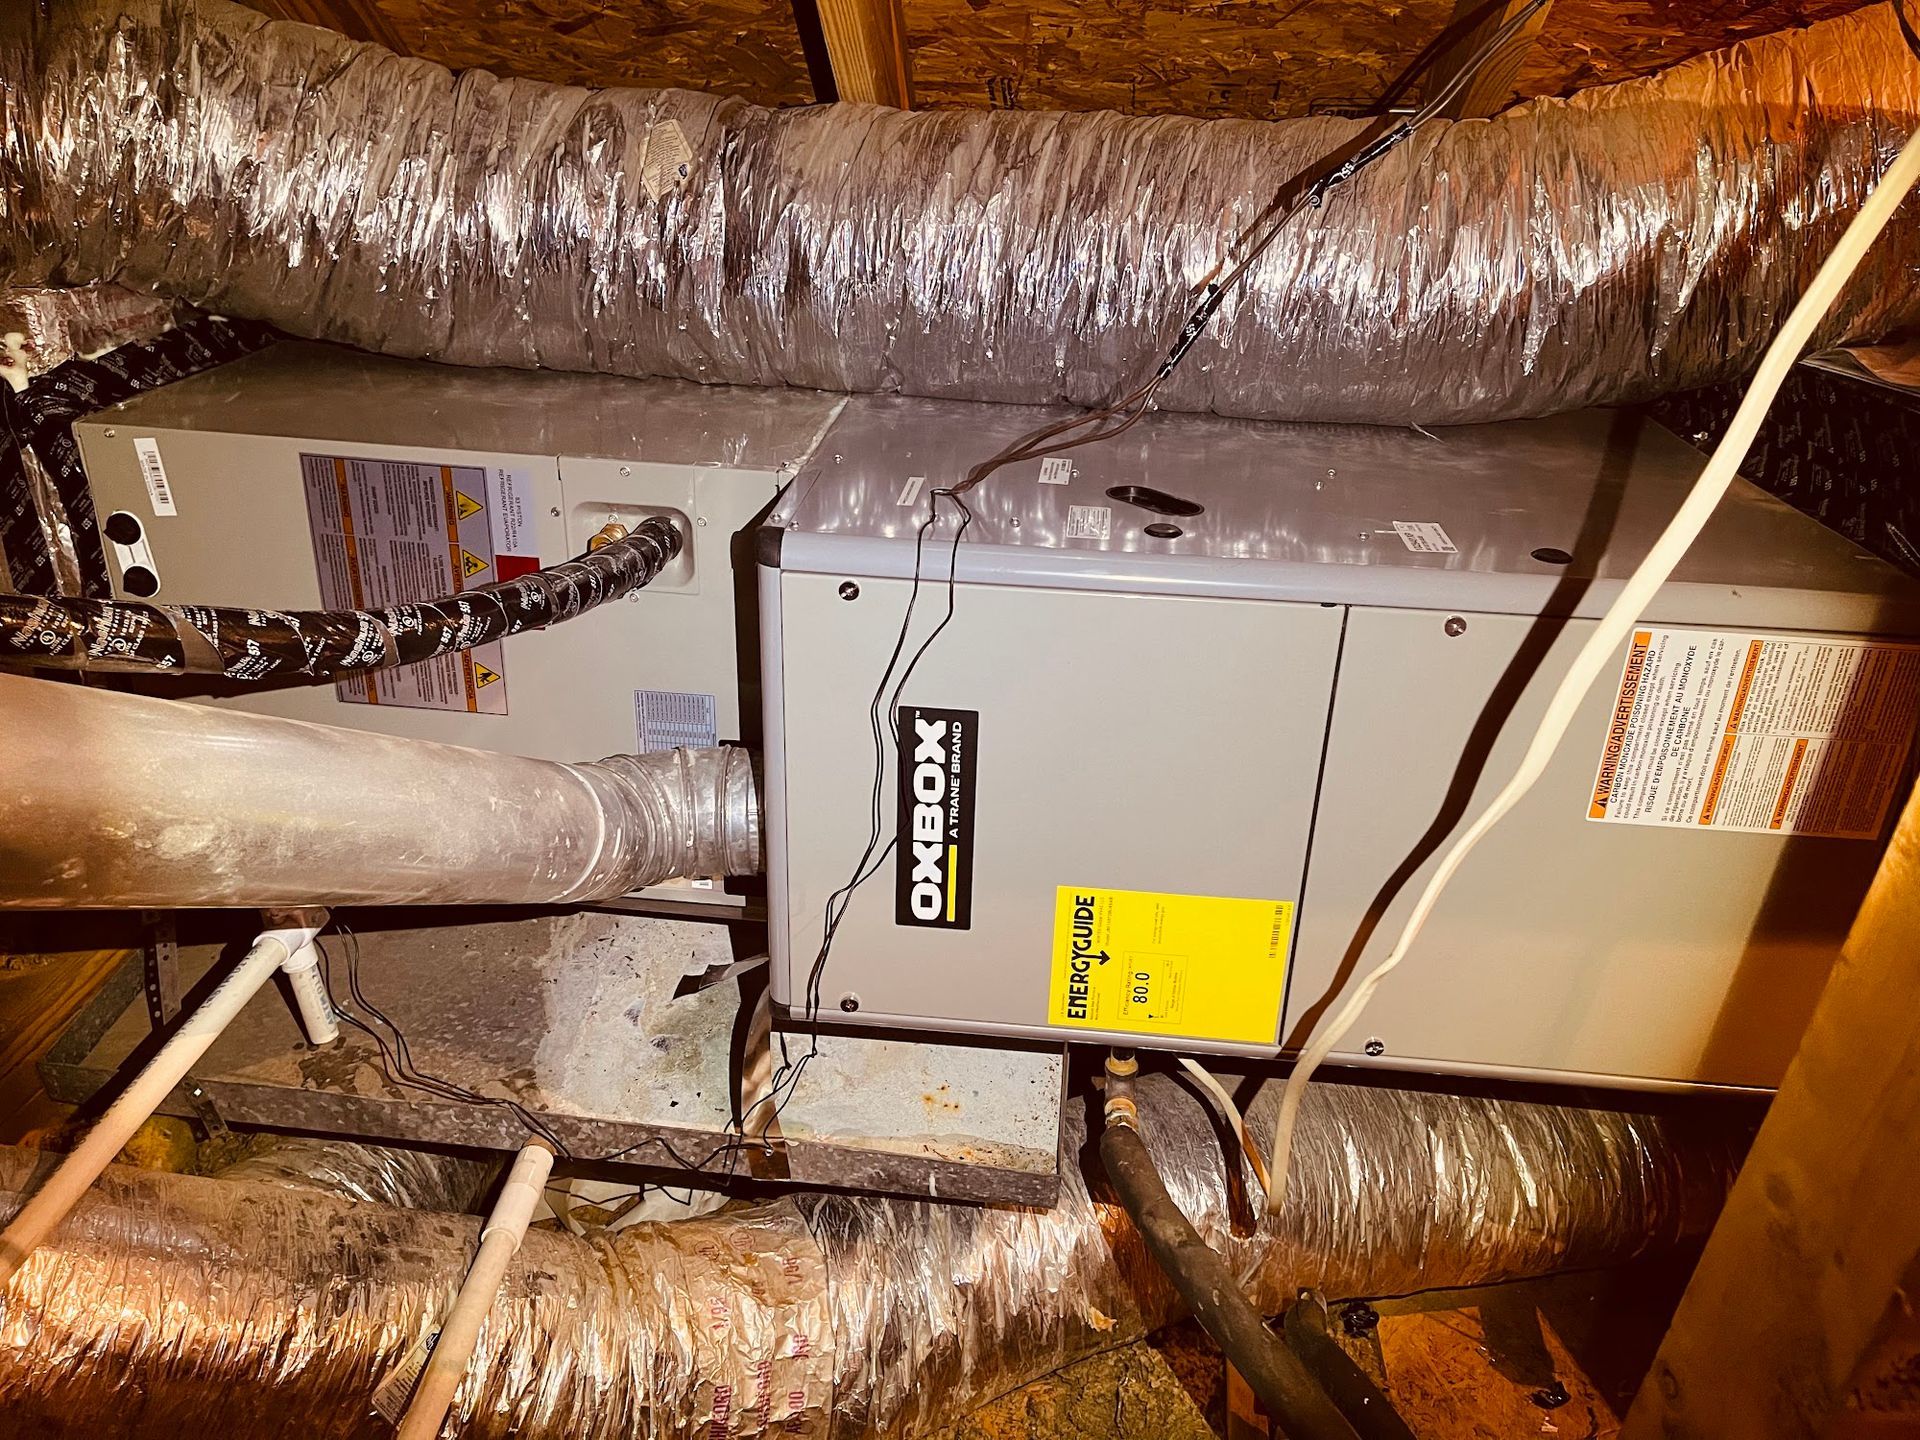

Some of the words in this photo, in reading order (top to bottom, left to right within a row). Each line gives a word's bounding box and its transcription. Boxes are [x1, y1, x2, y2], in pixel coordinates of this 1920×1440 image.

[498, 468, 508, 512] REFRIGERANT
[506, 474, 515, 515] REFRIGERANT
[502, 512, 512, 552] EVAPORATOR
[440, 626, 453, 644] 557
[1655, 634, 1668, 662] servicing
[1651, 664, 1660, 680] when
[1667, 662, 1680, 689] servicing
[1677, 645, 1696, 690] MONOXYDE
[1645, 682, 1656, 702] except
[1663, 690, 1673, 706] when
[1673, 692, 1683, 702] AU
[1717, 689, 1729, 712] moment
[1596, 643, 1647, 794] WARNING/ADVERTISSEMENT
[1639, 703, 1650, 723] closed
[1646, 702, 1659, 730] poisoning
[1657, 707, 1668, 726] except
[1673, 706, 1690, 744] CARBONE
[1609, 771, 1624, 803] CARBON
[1618, 730, 1635, 769] MONOXIDE
[1629, 685, 1647, 728] POISONING
[1640, 650, 1656, 682] HAZARD
[1652, 727, 1663, 746] closed
[951, 721, 962, 774] BRAND
[1629, 725, 1644, 761] compartment
[1638, 731, 1651, 758] monoxide
[1670, 746, 1679, 756] DE
[1633, 760, 1644, 779] carbon
[1646, 755, 1655, 769] must
[1622, 777, 1631, 789] keep
[1627, 786, 1637, 802] result
[1636, 770, 1651, 806] compartment
[1615, 799, 1625, 817] Failure
[1623, 803, 1632, 818] could
[1644, 785, 1658, 812] RISQUE
[911, 718, 947, 920] OXBOX
[1633, 807, 1641, 818] This
[949, 826, 959, 838] A
[1067, 895, 1095, 1019] ENERGYGUIDE
[1132, 972, 1150, 1004] 80.0
